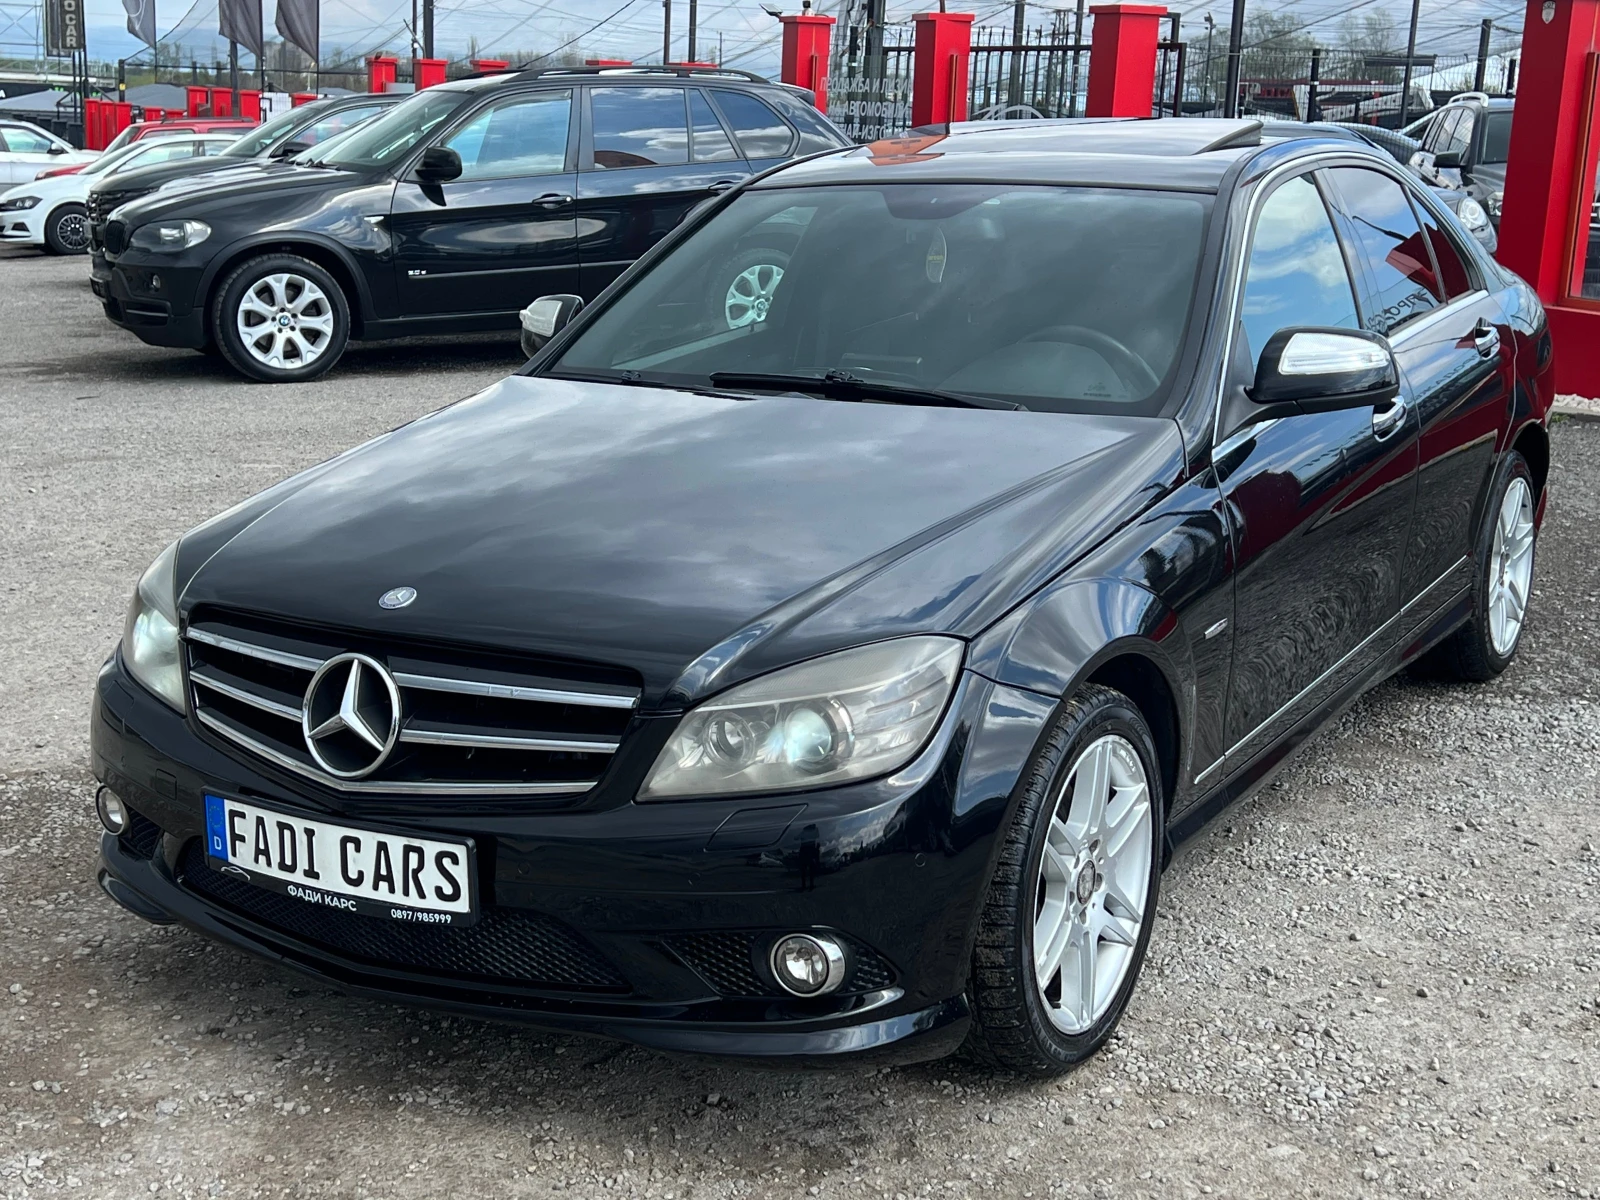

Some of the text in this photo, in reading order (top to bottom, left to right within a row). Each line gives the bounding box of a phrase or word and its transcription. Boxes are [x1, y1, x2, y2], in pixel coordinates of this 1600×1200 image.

[64, 0, 77, 47] OCAR
[820, 77, 914, 95] ПРОДАЖБА И ЛИЗИН
[842, 101, 909, 118] АВТОМОБИЛИ
[839, 123, 886, 140] НАЙ-ИЗГО
[214, 835, 222, 851] D
[228, 808, 462, 903] FADI CARS
[287, 884, 358, 912] ФАДИ КАРС
[390, 908, 452, 924] 0897/985999
